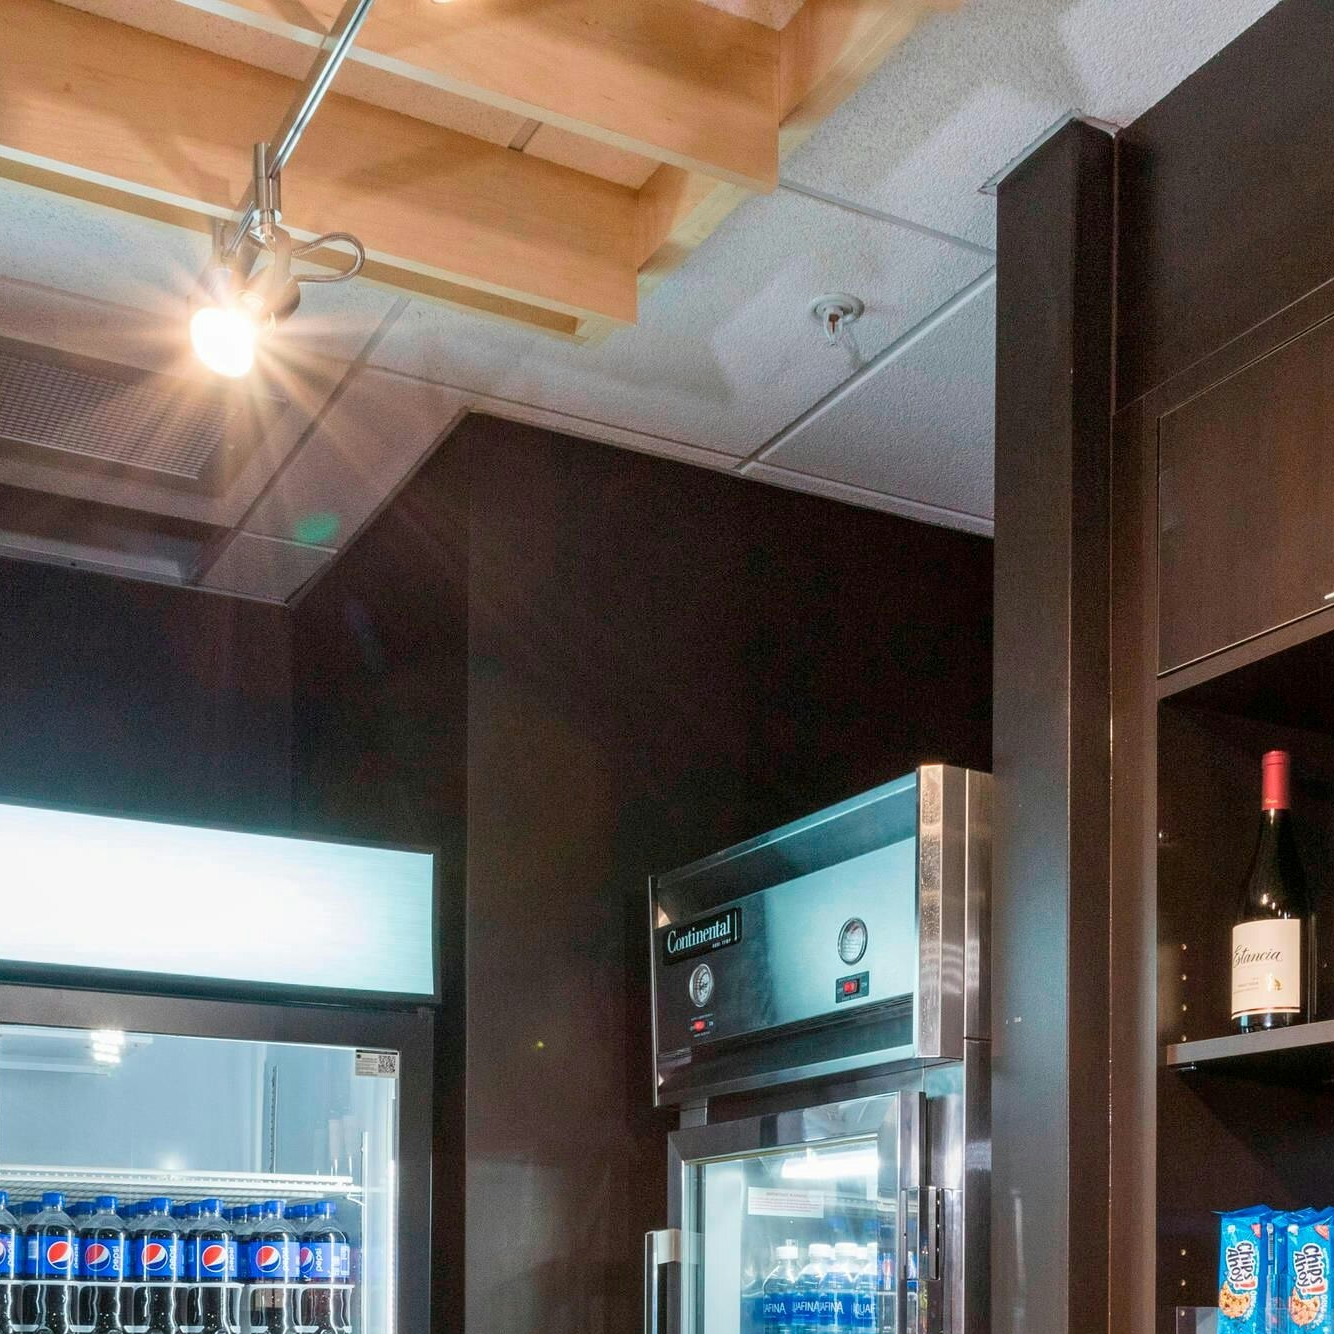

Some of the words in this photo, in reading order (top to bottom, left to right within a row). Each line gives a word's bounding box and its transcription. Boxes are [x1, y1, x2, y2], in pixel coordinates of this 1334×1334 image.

[667, 914, 732, 954] Continental
[1233, 944, 1283, 968] Estancia
[112, 1245, 120, 1271] pepsi
[316, 1247, 324, 1272] pepsi
[1236, 1240, 1254, 1282] Chips
[1303, 1243, 1324, 1290] Chips
